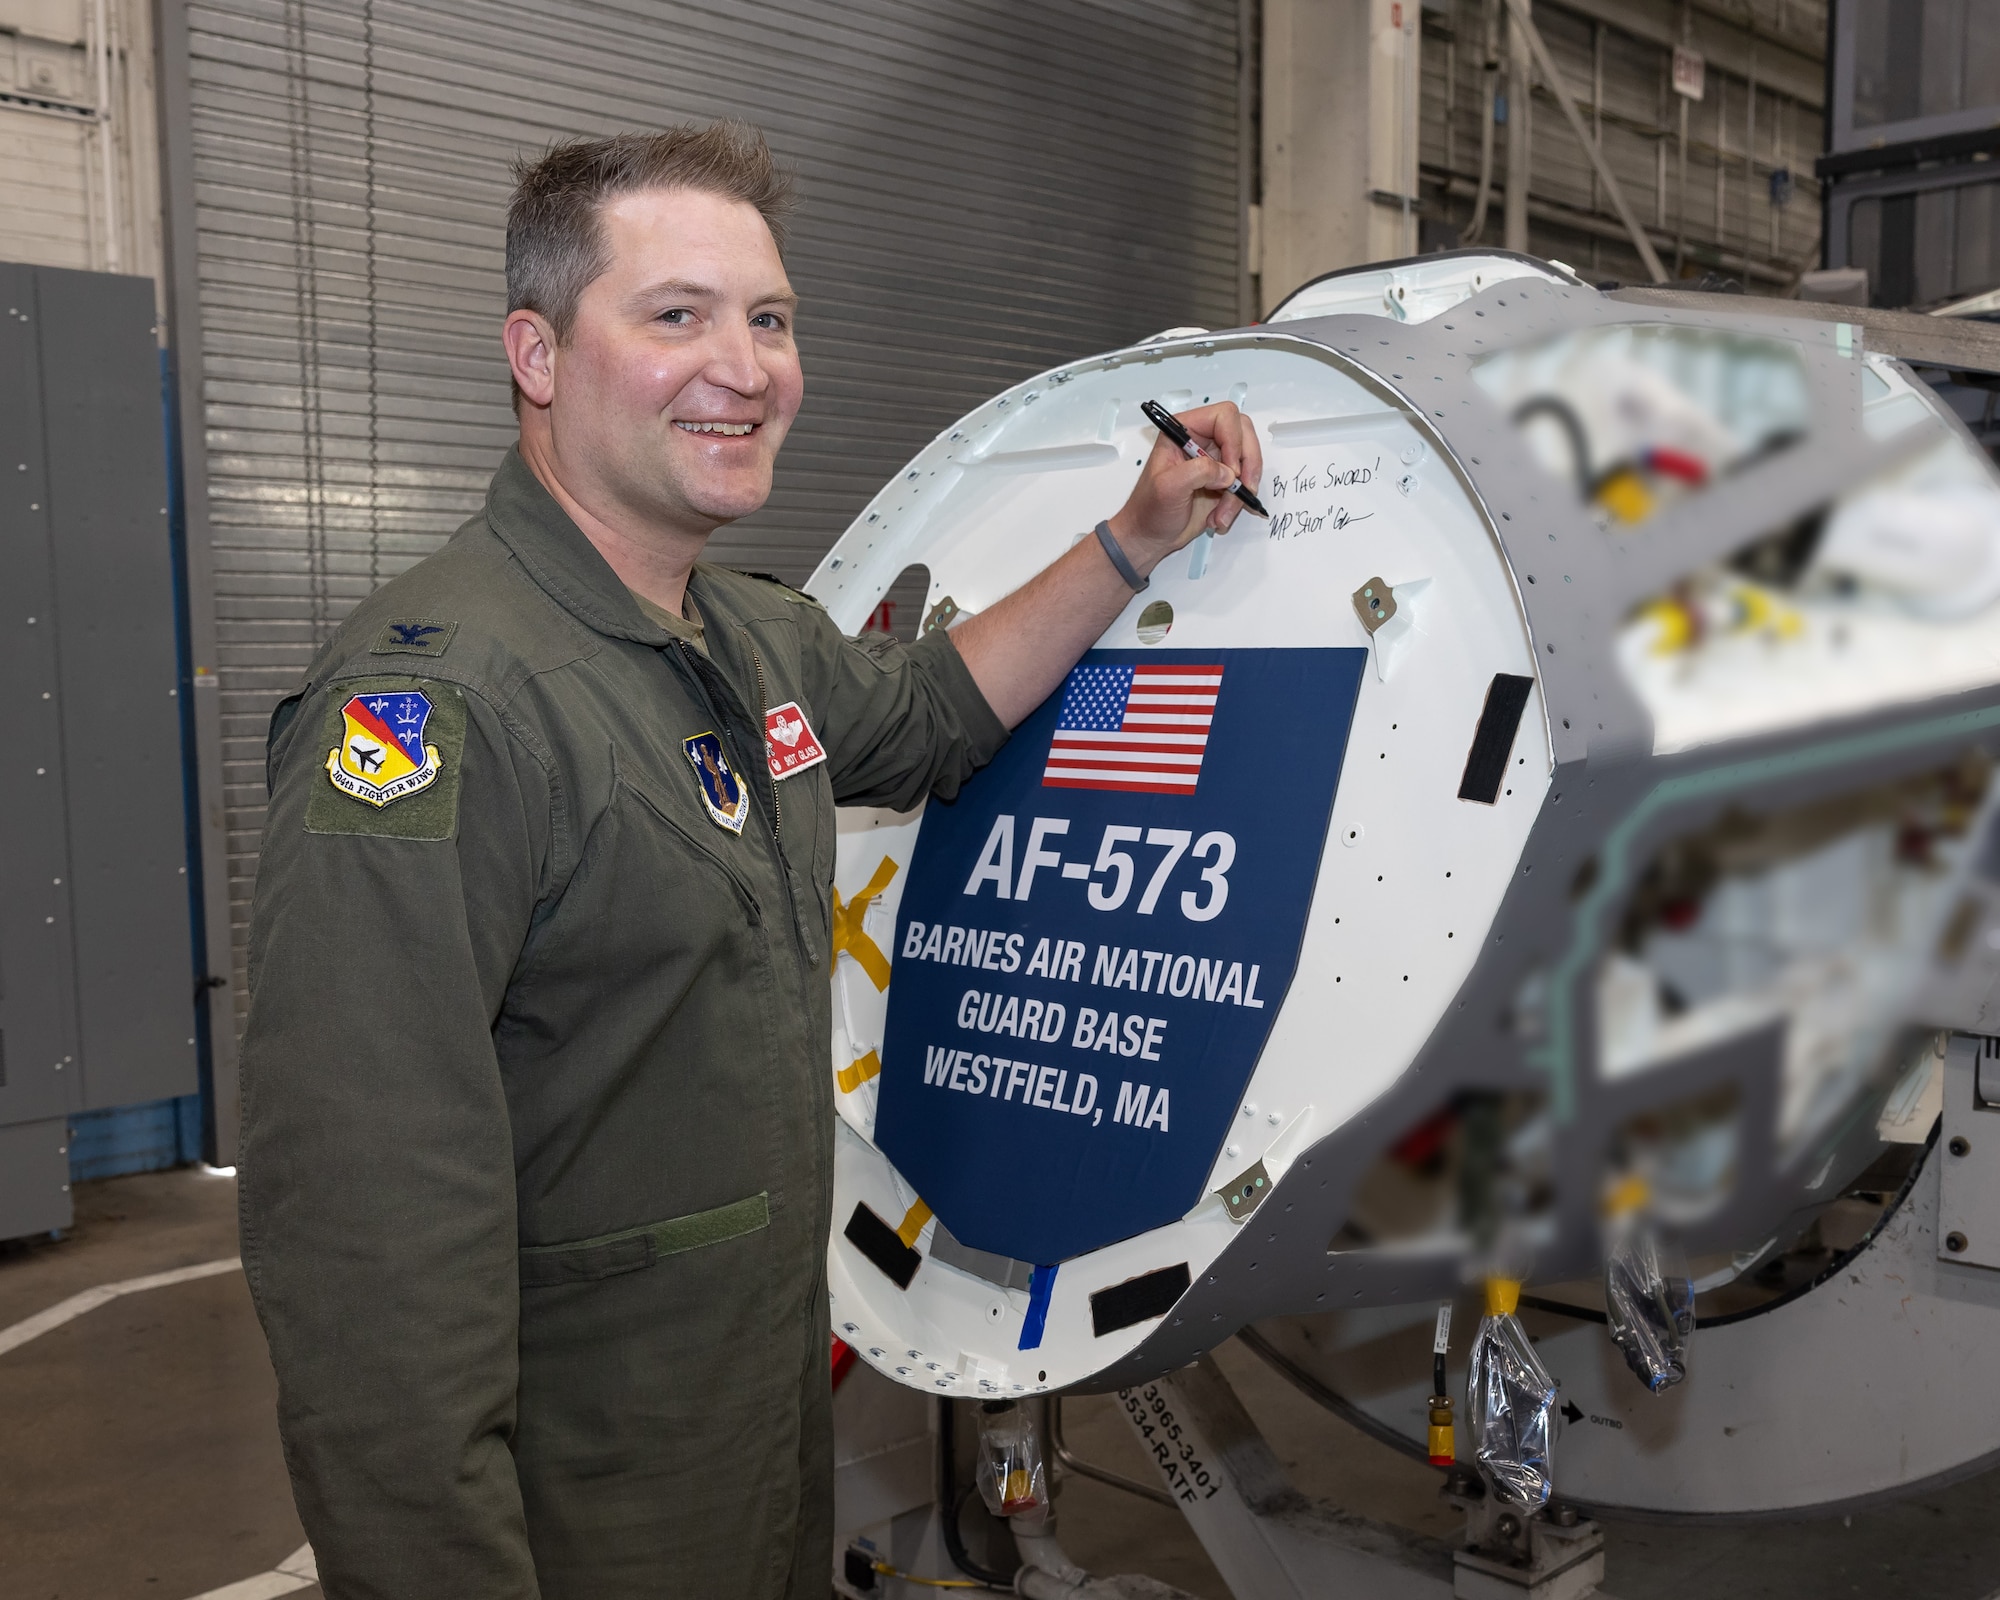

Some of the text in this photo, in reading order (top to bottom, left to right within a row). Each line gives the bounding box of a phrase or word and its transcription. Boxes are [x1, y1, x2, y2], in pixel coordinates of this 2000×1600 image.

[333, 767, 434, 801] 104th FIGHTER WING
[798, 745, 818, 760] GLASS
[963, 814, 1237, 922] AF-573
[902, 921, 1265, 1009] BARNES AIR NATIONAL
[957, 989, 1168, 1061] GUARD BASE
[923, 1045, 1171, 1133] WESTFIELD, MA
[1143, 1385, 1219, 1500] 3965-3401
[1590, 1414, 1623, 1430] OUTBD
